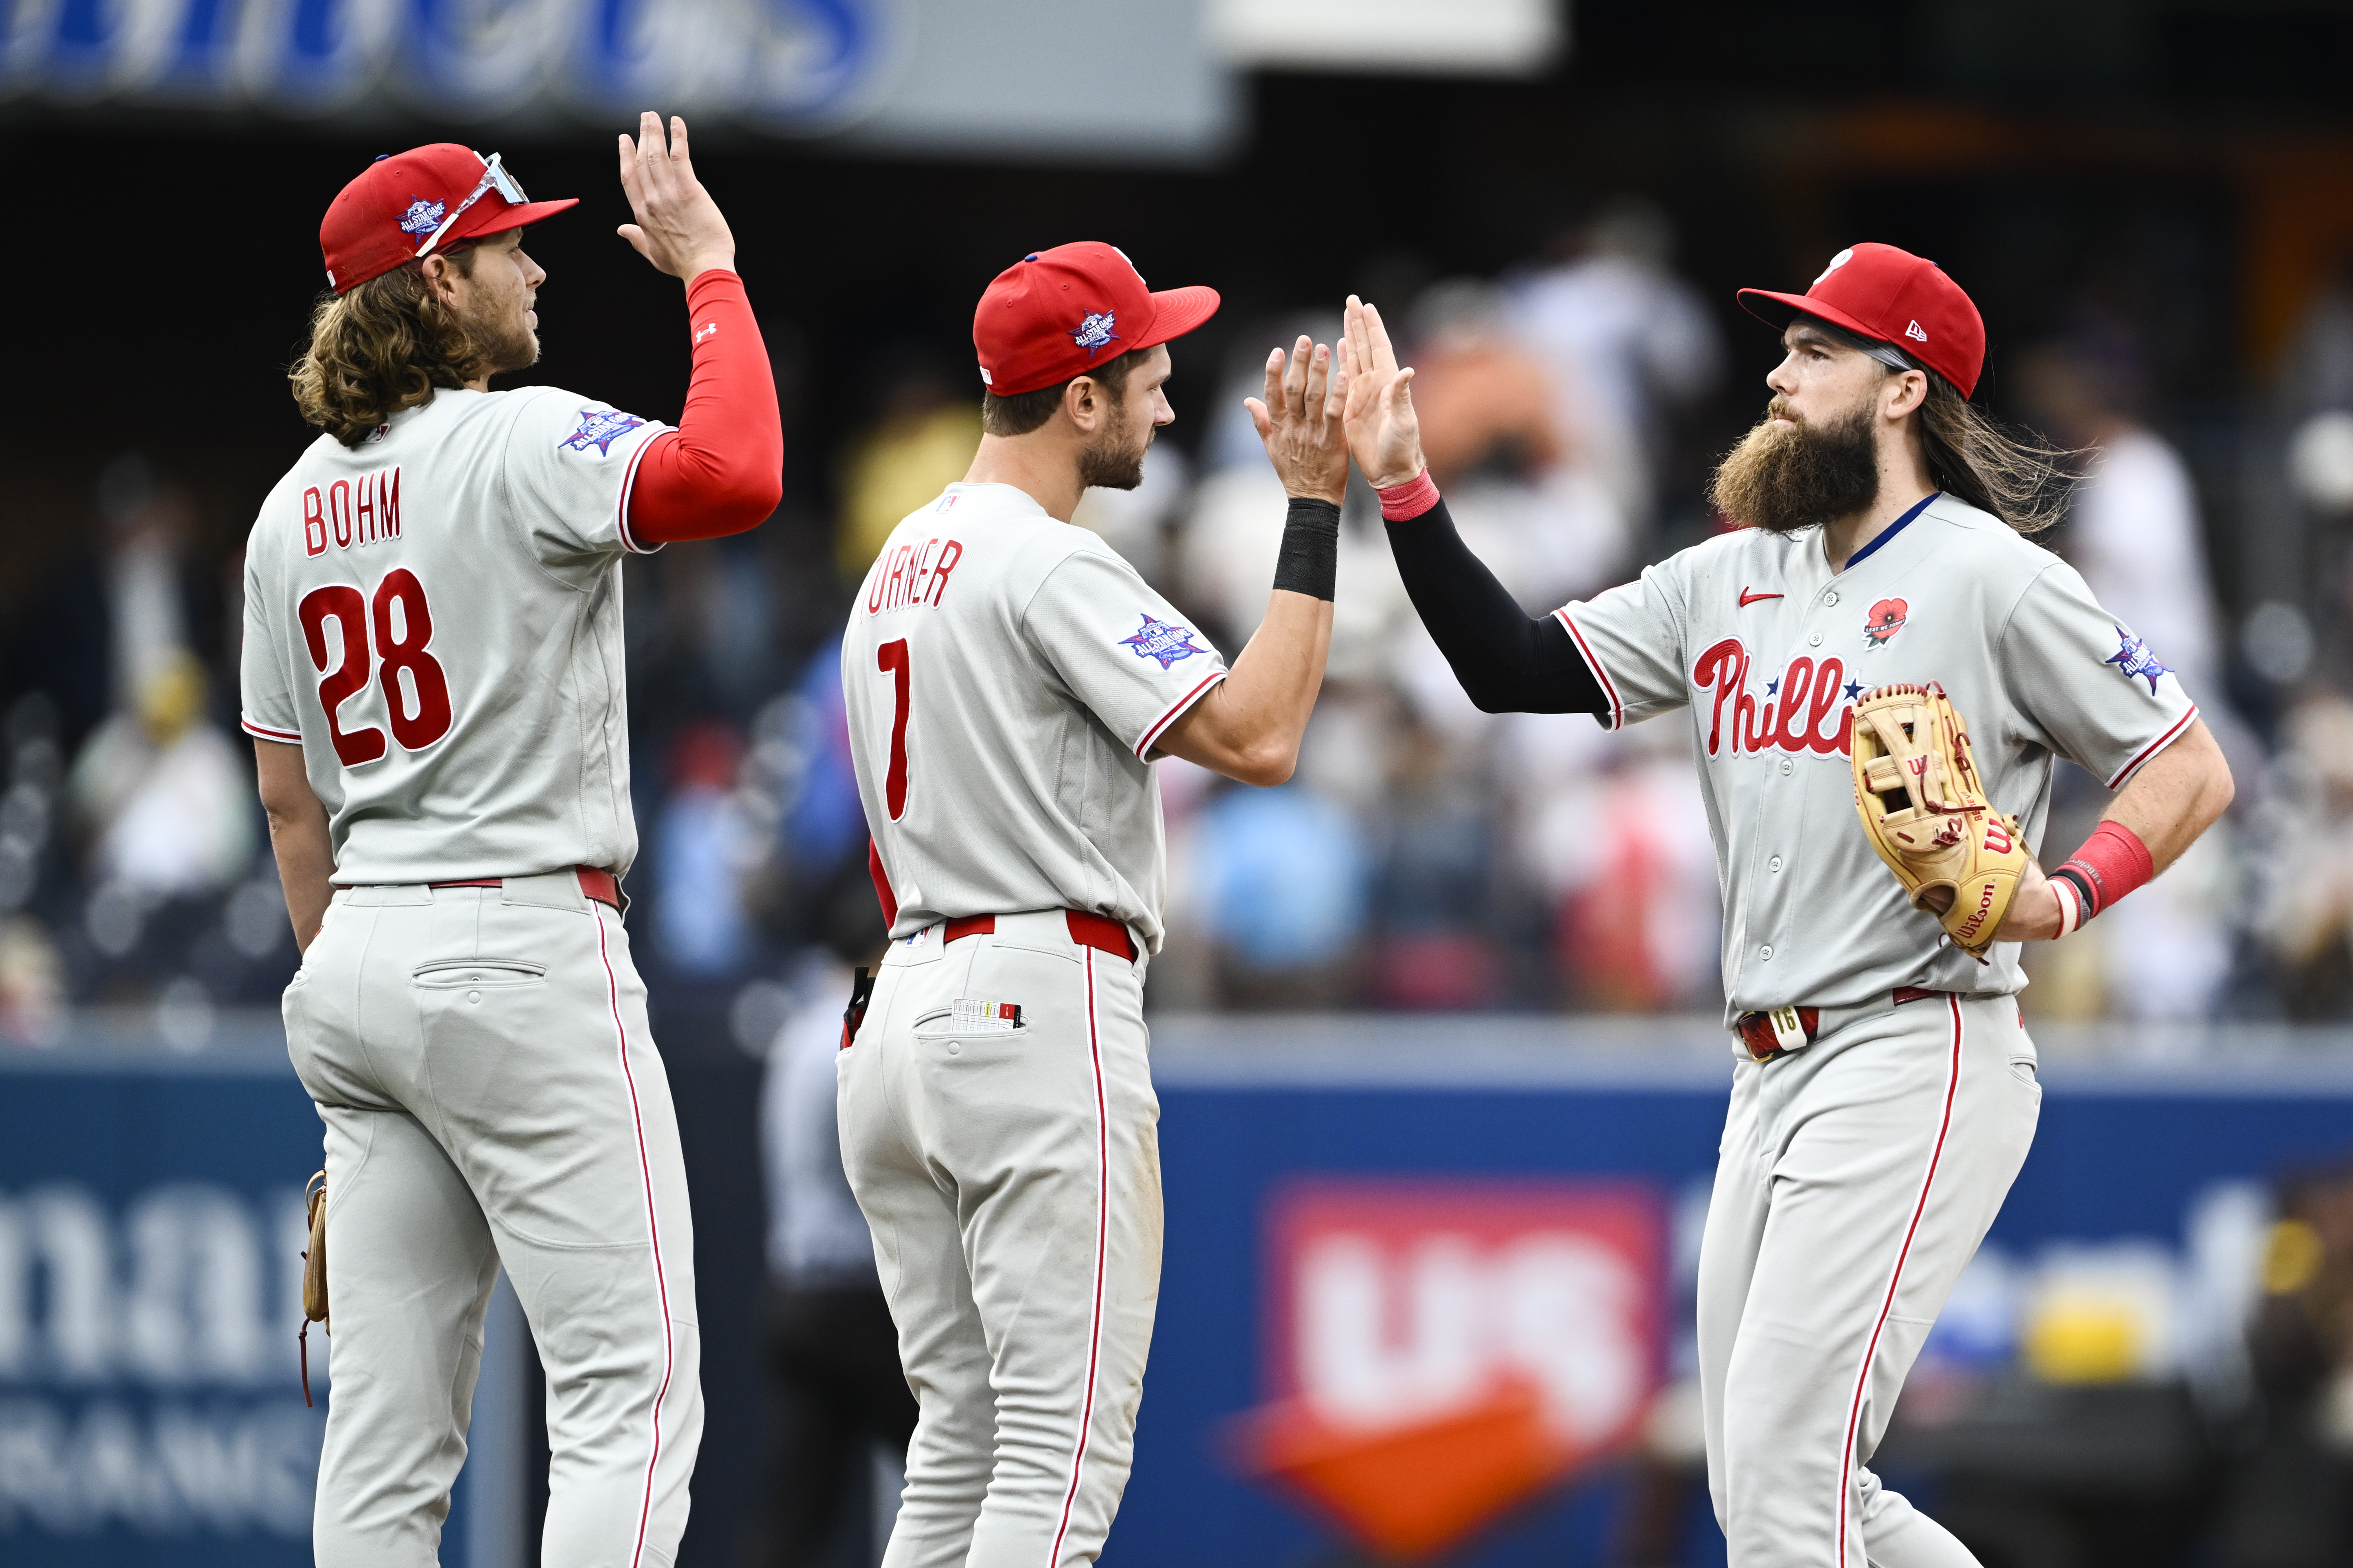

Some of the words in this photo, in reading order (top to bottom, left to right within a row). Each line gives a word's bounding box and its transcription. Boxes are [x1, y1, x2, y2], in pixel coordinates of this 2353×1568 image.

[401, 219, 414, 231] ALL
[412, 211, 427, 223] STAR
[426, 202, 445, 216] GAME
[1075, 334, 1089, 345] ALL
[1086, 324, 1100, 338] STAR
[1099, 314, 1115, 328] GAME
[573, 435, 593, 448] ALL
[588, 421, 611, 436] STAR
[304, 465, 401, 558] BOHM
[1135, 640, 1155, 655] ALL
[1149, 633, 1170, 649] STAR
[1166, 628, 1191, 640] GAME
[297, 566, 454, 769] 28
[2123, 657, 2141, 675] ALL
[1691, 636, 1861, 759] Philli
[877, 636, 912, 823] 7
[1960, 791, 1983, 821] BEIEVE
[1982, 817, 2012, 855] W
[1955, 883, 1994, 938] Wilson
[1773, 1007, 1796, 1034] 16
